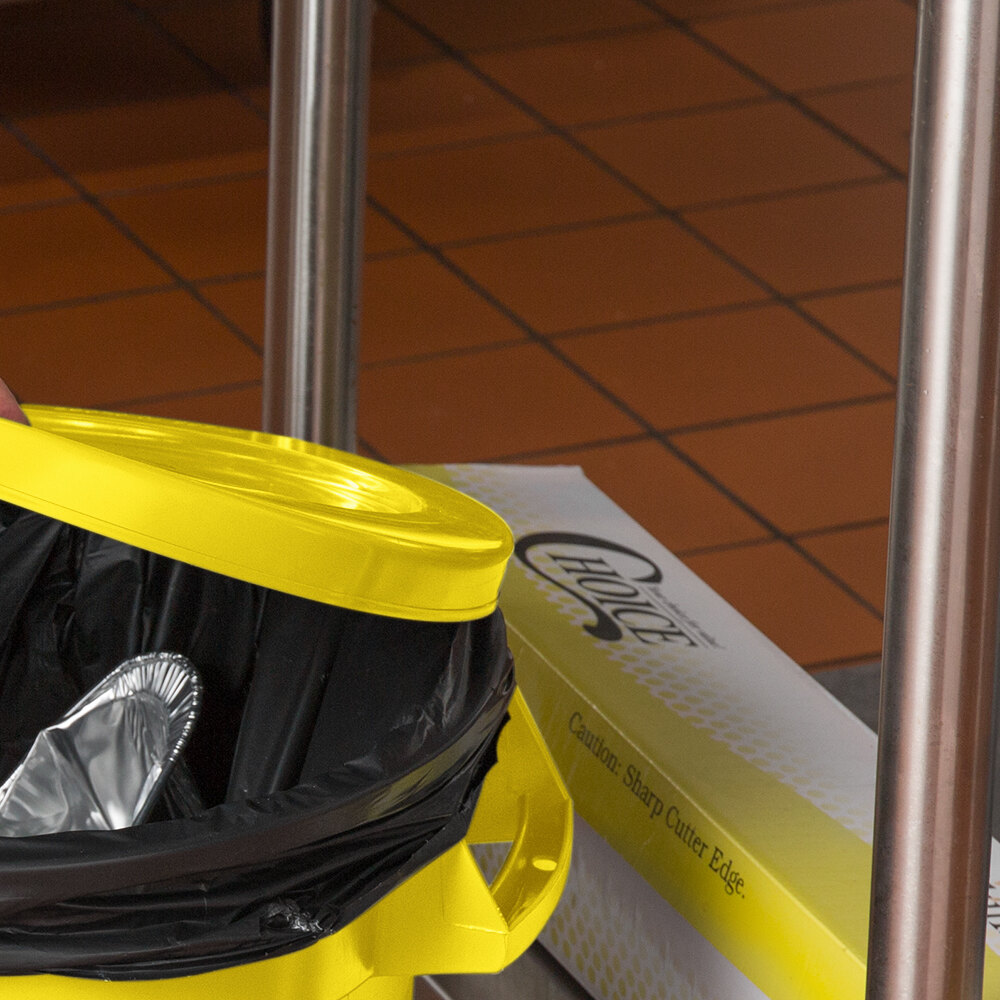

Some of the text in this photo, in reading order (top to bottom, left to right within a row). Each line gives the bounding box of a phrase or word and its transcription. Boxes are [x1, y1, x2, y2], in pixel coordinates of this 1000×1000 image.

[514, 531, 698, 648] CHOICE
[568, 711, 745, 899] Caution: Sharp Cutter Edge.
